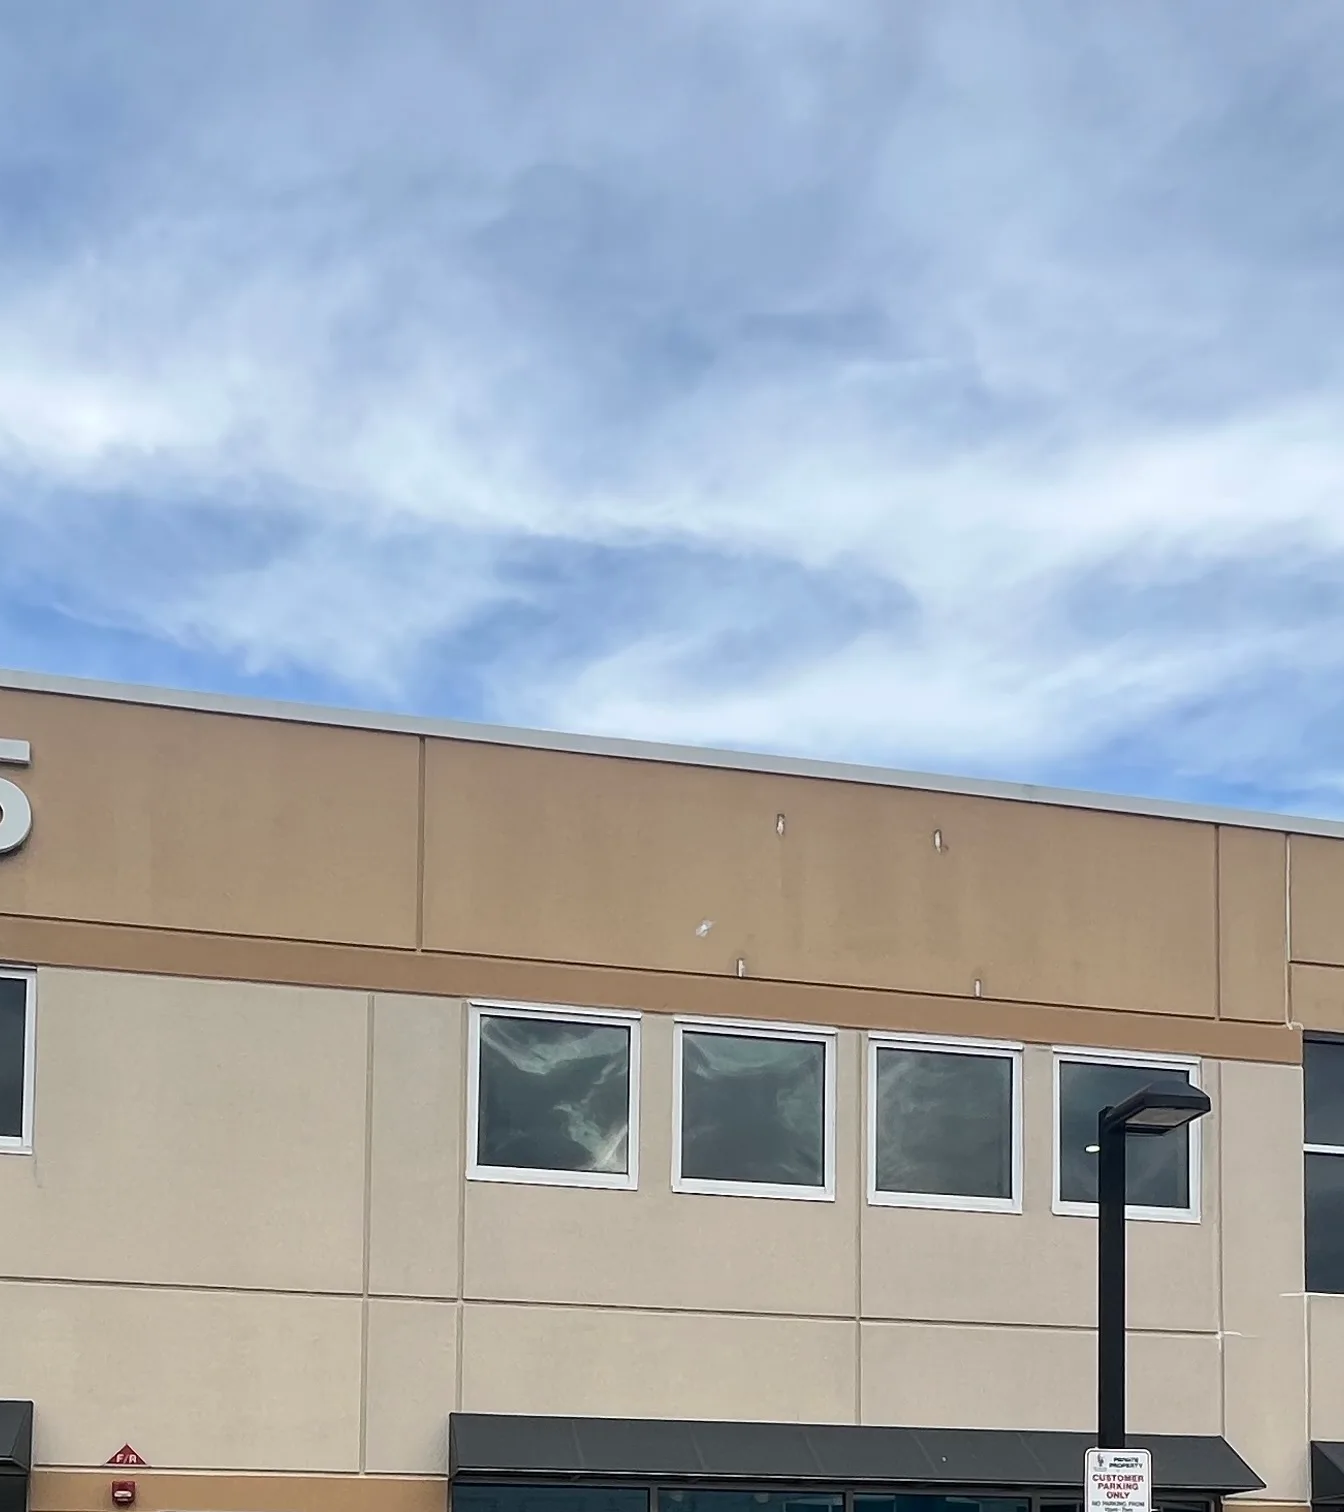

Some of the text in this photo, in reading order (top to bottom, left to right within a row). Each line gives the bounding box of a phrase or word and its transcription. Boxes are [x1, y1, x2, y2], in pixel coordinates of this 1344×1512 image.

[1092, 1474, 1144, 1482] CUSTOMER
[1097, 1482, 1139, 1490] PARKING
[1106, 1491, 1130, 1499] ONLY
